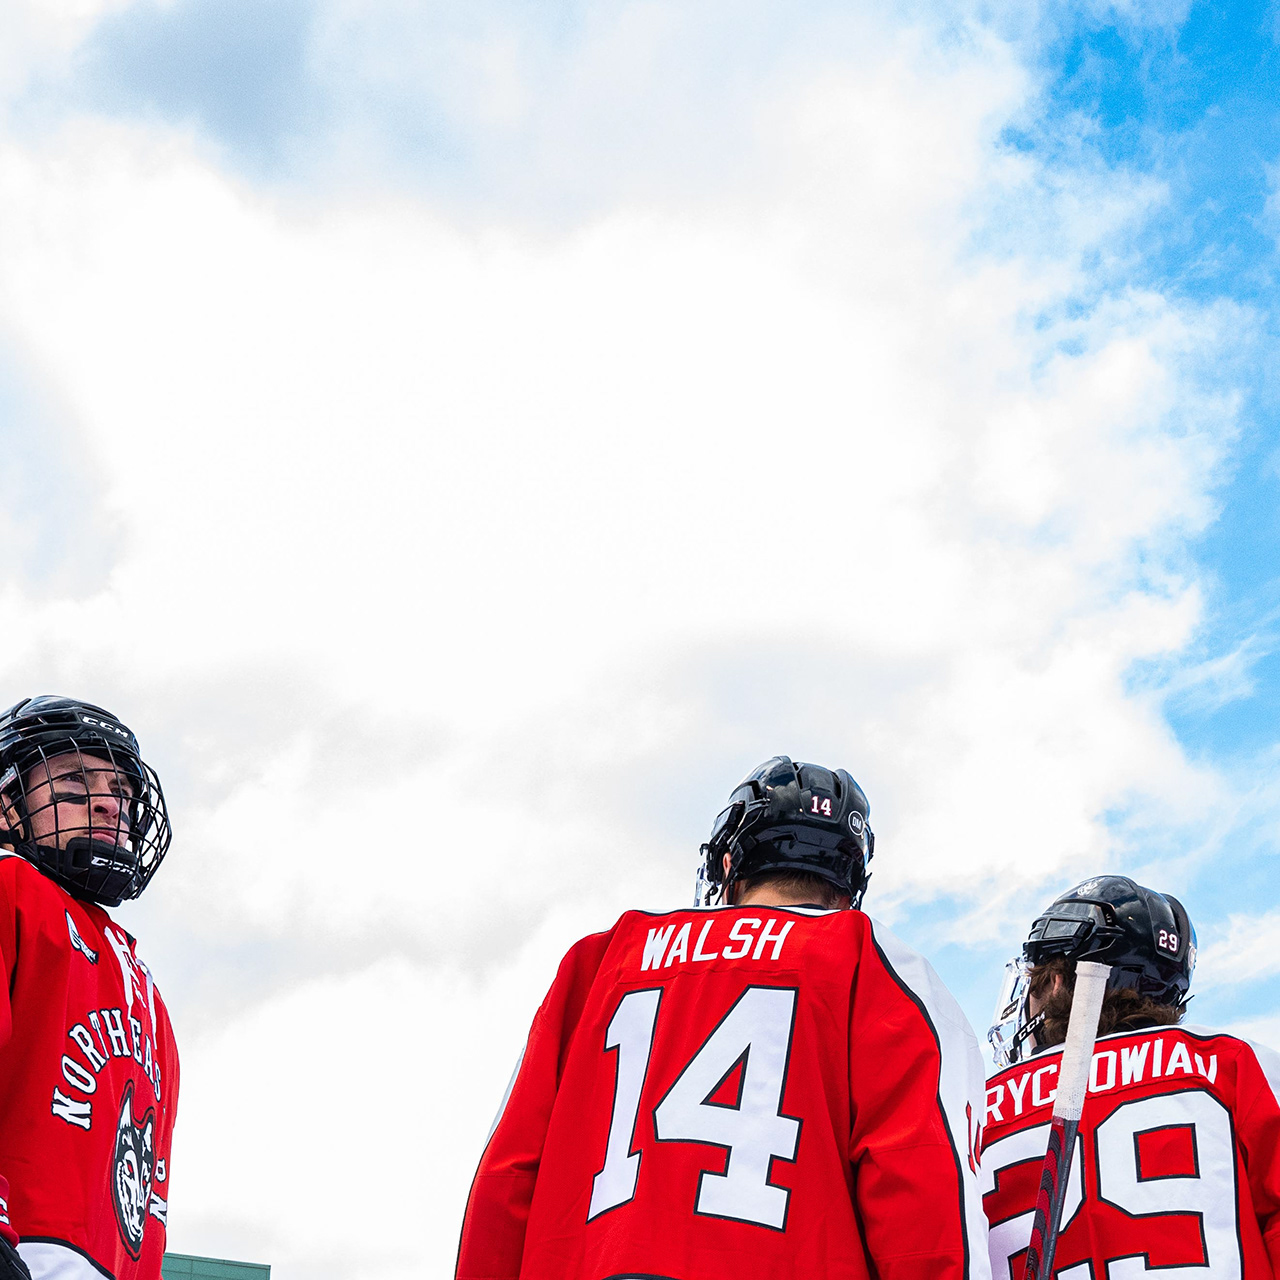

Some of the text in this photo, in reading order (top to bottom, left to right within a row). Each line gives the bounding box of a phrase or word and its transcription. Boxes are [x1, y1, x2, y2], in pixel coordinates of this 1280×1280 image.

[82, 714, 130, 739] CCM
[810, 795, 832, 816] 14
[851, 816, 862, 829] DM
[640, 917, 796, 972] WALSH
[1157, 928, 1179, 952] 29
[1018, 1012, 1046, 1041] CCM
[586, 984, 804, 1234] 14
